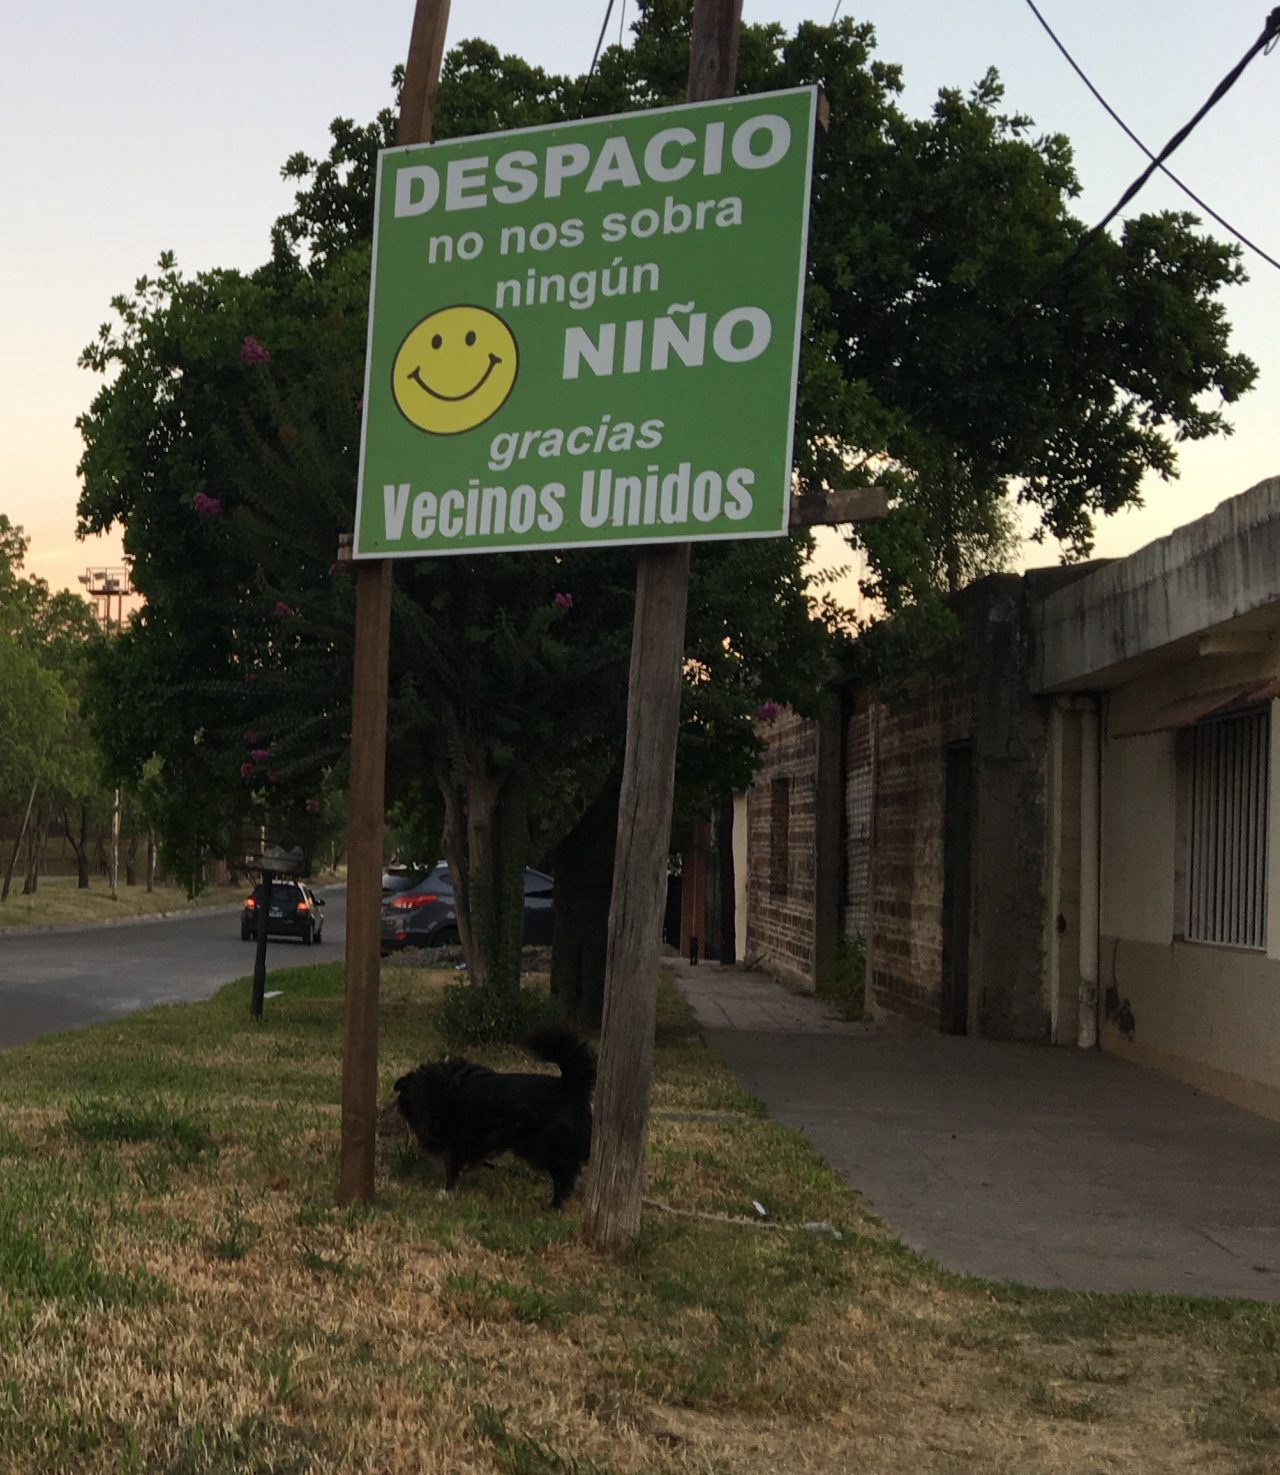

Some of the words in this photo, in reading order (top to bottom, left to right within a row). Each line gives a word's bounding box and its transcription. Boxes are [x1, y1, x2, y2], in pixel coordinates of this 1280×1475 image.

[393, 113, 792, 219] DESPACIO
[427, 231, 484, 265] no
[499, 217, 585, 256] nos
[600, 194, 743, 243] sobra
[495, 256, 660, 311] ningún
[561, 300, 773, 381] NIÑO
[487, 414, 666, 473] gracias
[382, 478, 567, 541] Vecinos
[578, 461, 756, 529] Unidos
